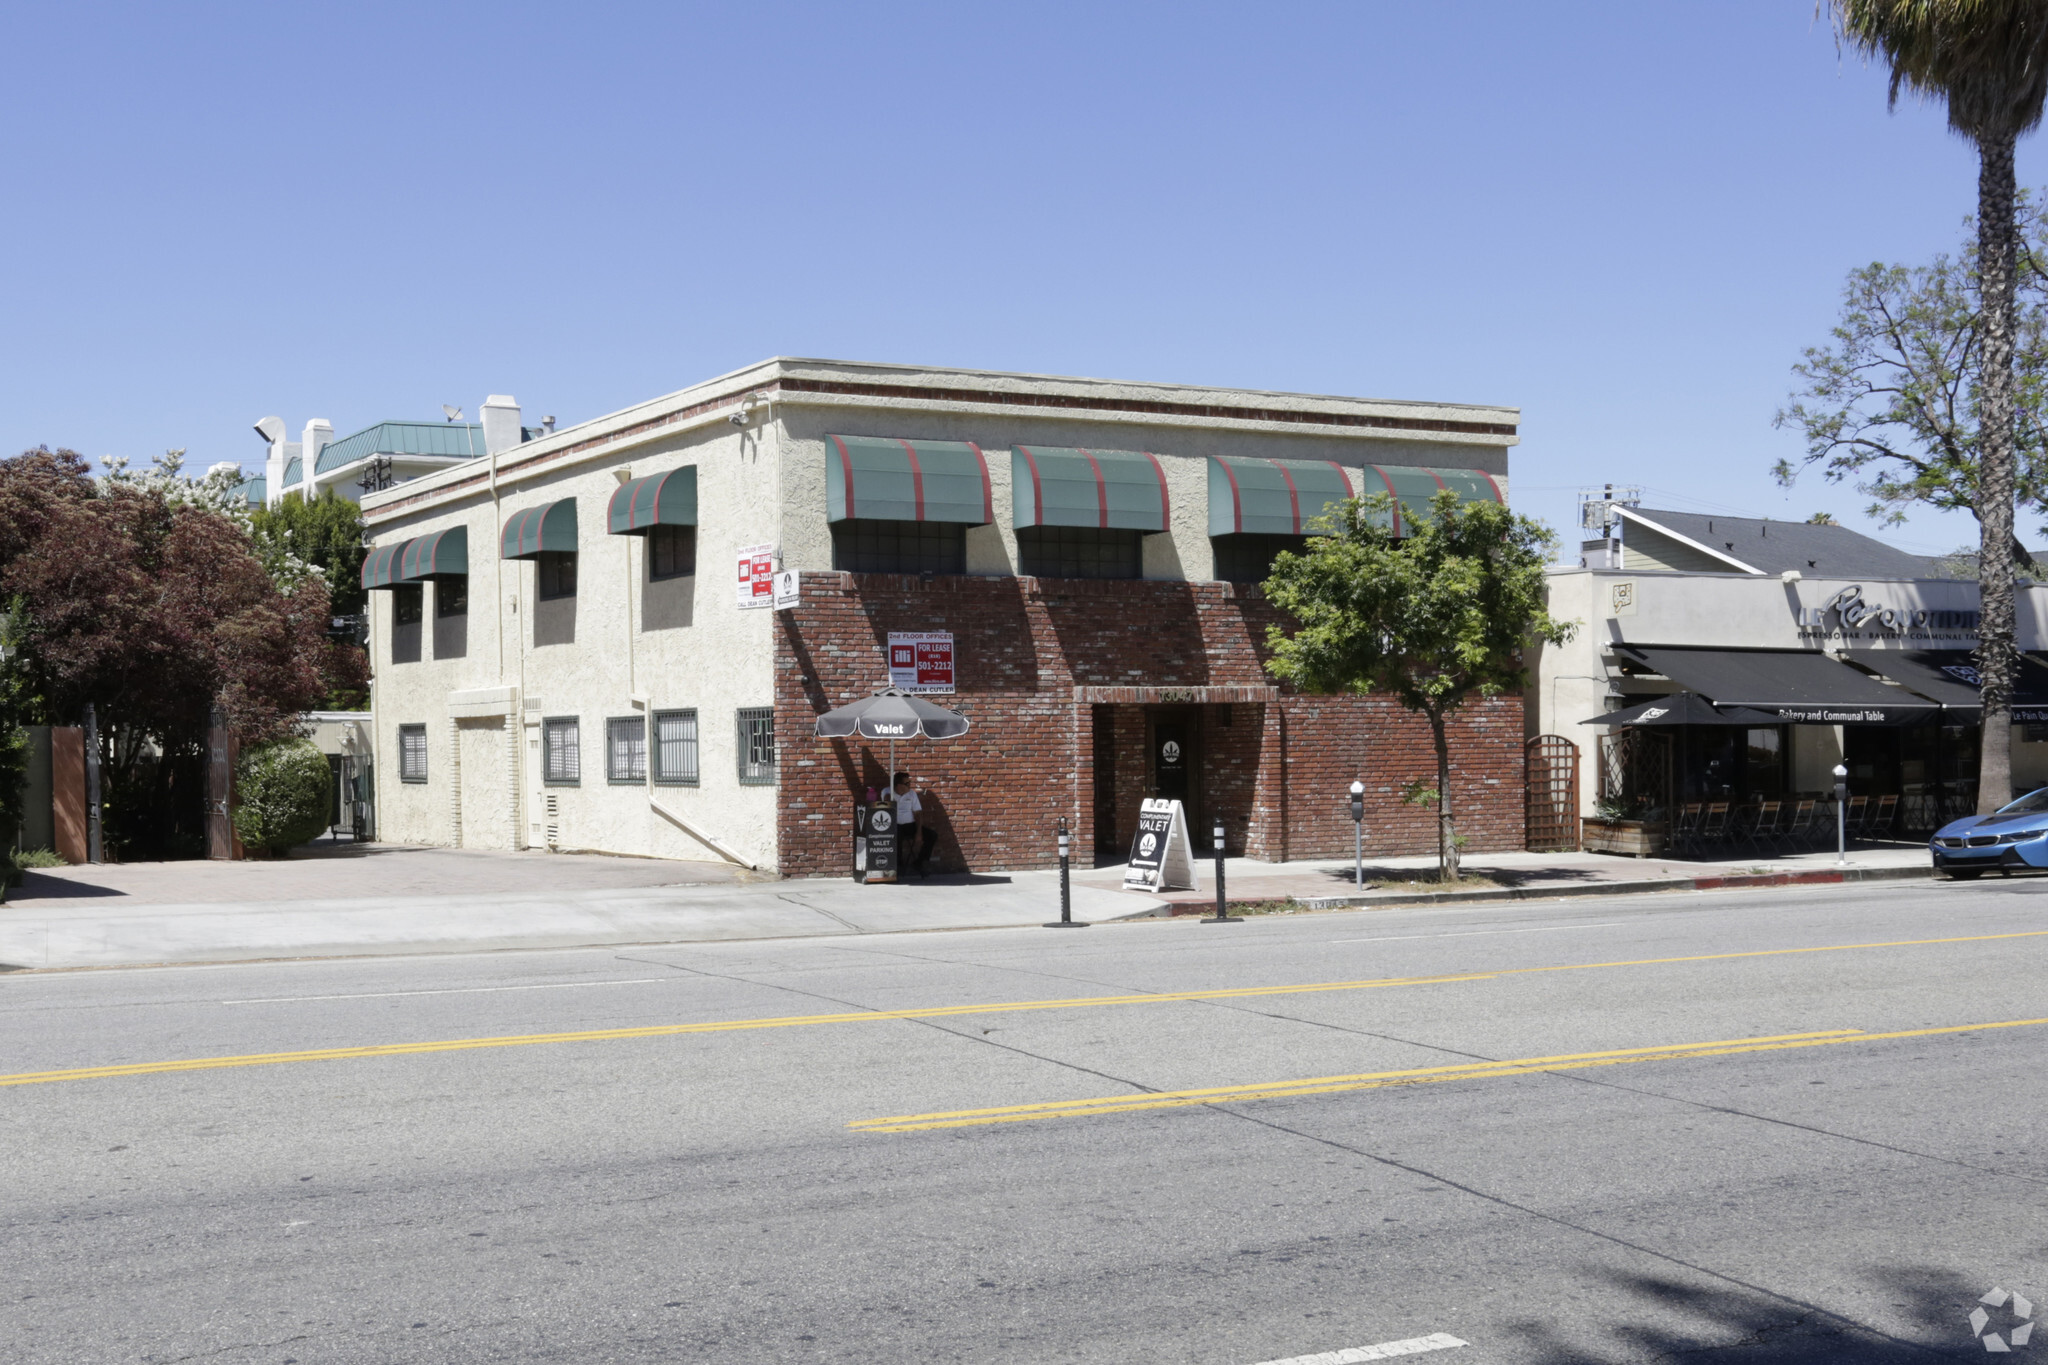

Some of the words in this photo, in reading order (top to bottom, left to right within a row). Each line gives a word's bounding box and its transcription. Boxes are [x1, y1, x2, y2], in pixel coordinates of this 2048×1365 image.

[1799, 607, 1823, 627] LE
[1797, 631, 1841, 640] ESPRESSO
[1843, 631, 1860, 639] BAR
[1868, 632, 1902, 640] BAKERY
[895, 650, 911, 662] illi
[918, 662, 952, 670] 501-2212
[1779, 708, 1806, 721] Bakery
[1806, 709, 1822, 721] and
[1823, 710, 1863, 721] Communal
[1864, 710, 1885, 721] Table
[2012, 711, 2021, 721] Le
[2022, 710, 2037, 720] Pain
[874, 723, 904, 734] Valet
[1139, 819, 1169, 832] VALET
